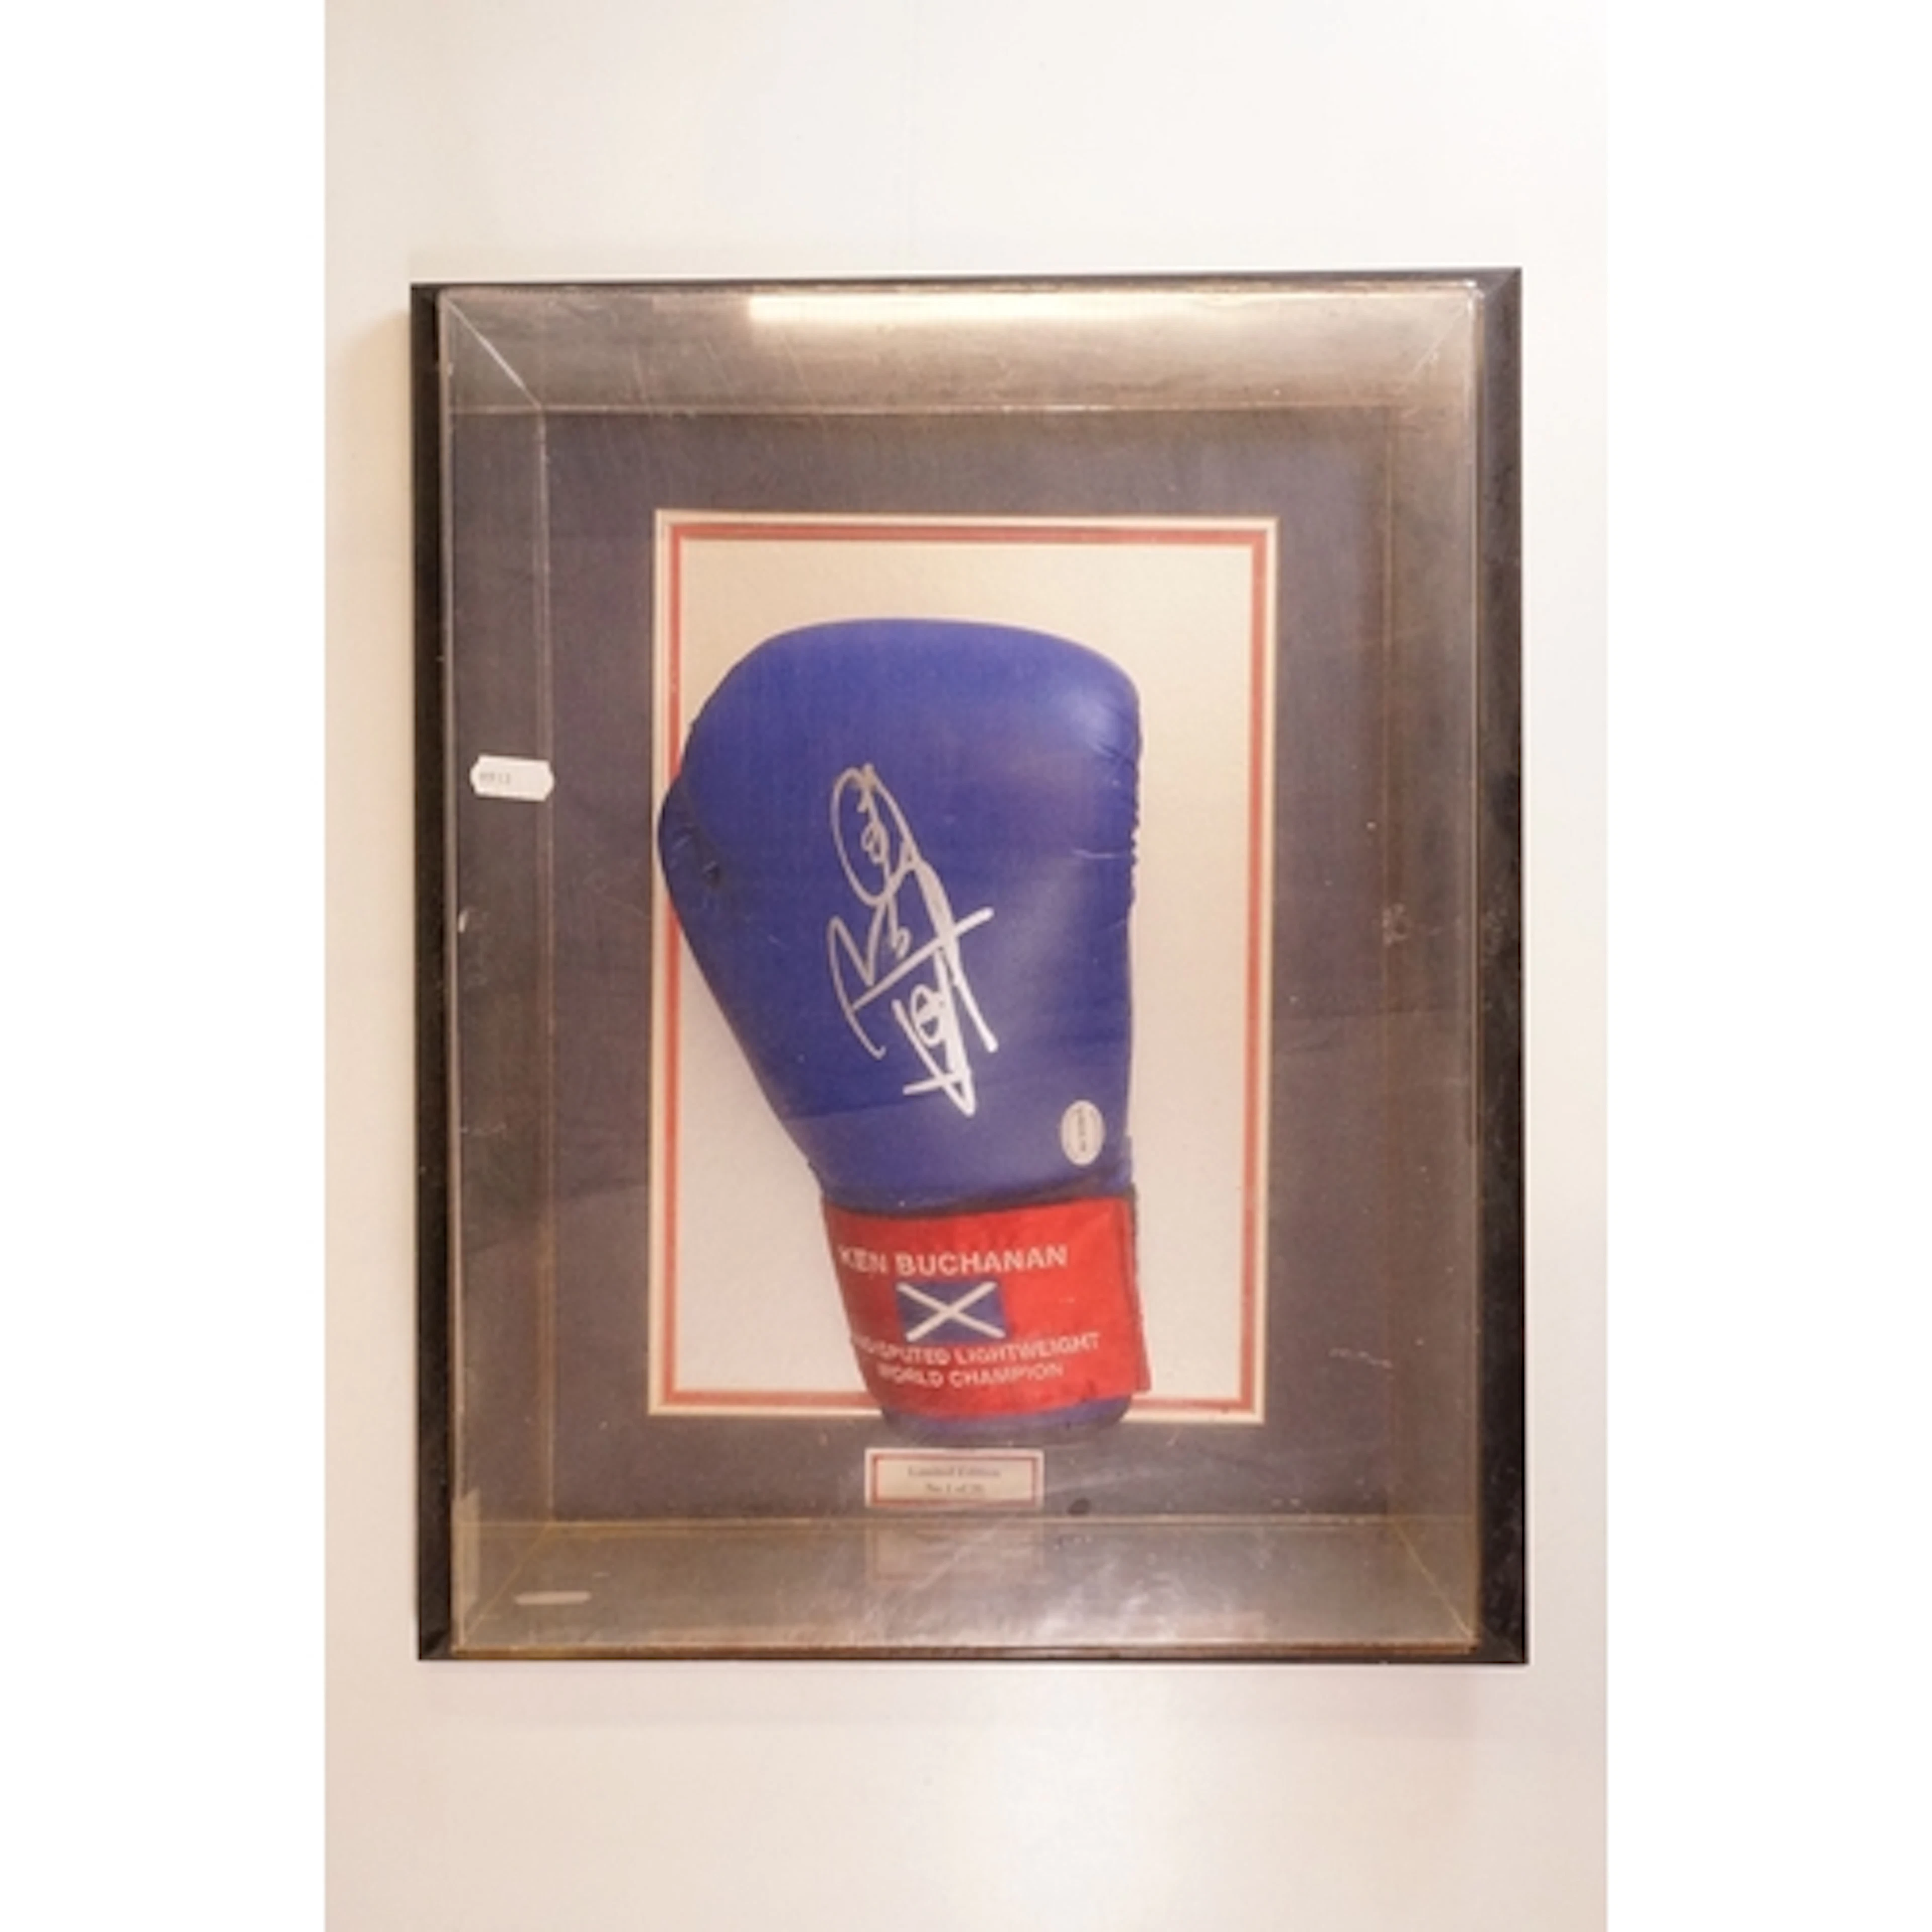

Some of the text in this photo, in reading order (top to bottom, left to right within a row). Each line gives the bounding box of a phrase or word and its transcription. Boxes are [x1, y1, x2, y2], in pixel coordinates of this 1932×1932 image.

[838, 1245, 1068, 1275] KEN BUCHANAN
[854, 1332, 1100, 1365] DISPUTED LIGHTWEIGHT
[876, 1362, 1064, 1388] WORLD CHAMPION
